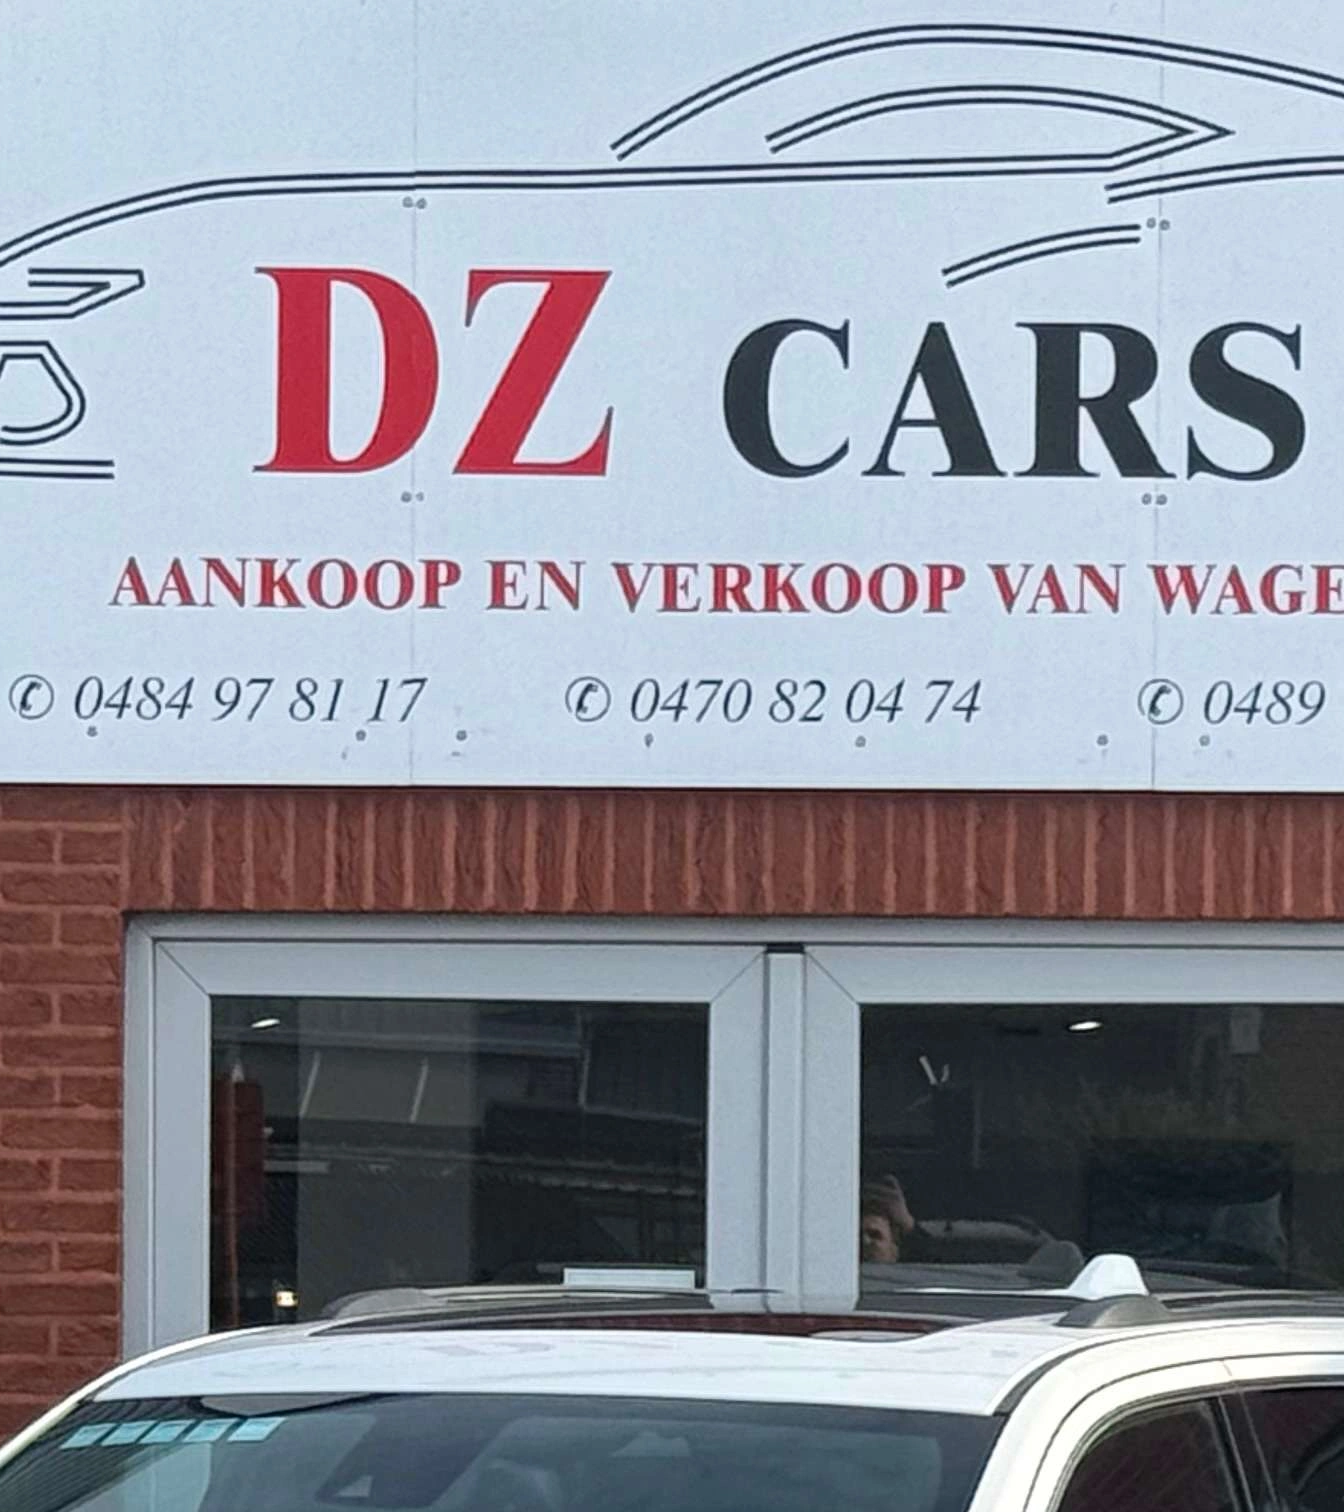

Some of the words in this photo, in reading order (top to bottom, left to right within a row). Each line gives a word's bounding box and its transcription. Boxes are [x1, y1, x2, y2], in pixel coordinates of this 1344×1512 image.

[253, 267, 614, 476] DZ
[723, 319, 1307, 481] CARS
[109, 556, 462, 610] AANKOOP
[486, 559, 586, 611] EN
[611, 562, 966, 614] VERKOOP
[987, 563, 1126, 614] VAN
[74, 675, 195, 723] 0484
[213, 677, 275, 722] 97
[288, 677, 344, 722] 81
[367, 677, 429, 723] 17
[630, 678, 753, 723] 0470
[768, 678, 827, 723] 82
[845, 678, 906, 723] 04
[925, 679, 981, 723] 74
[1203, 680, 1326, 725] 0489
